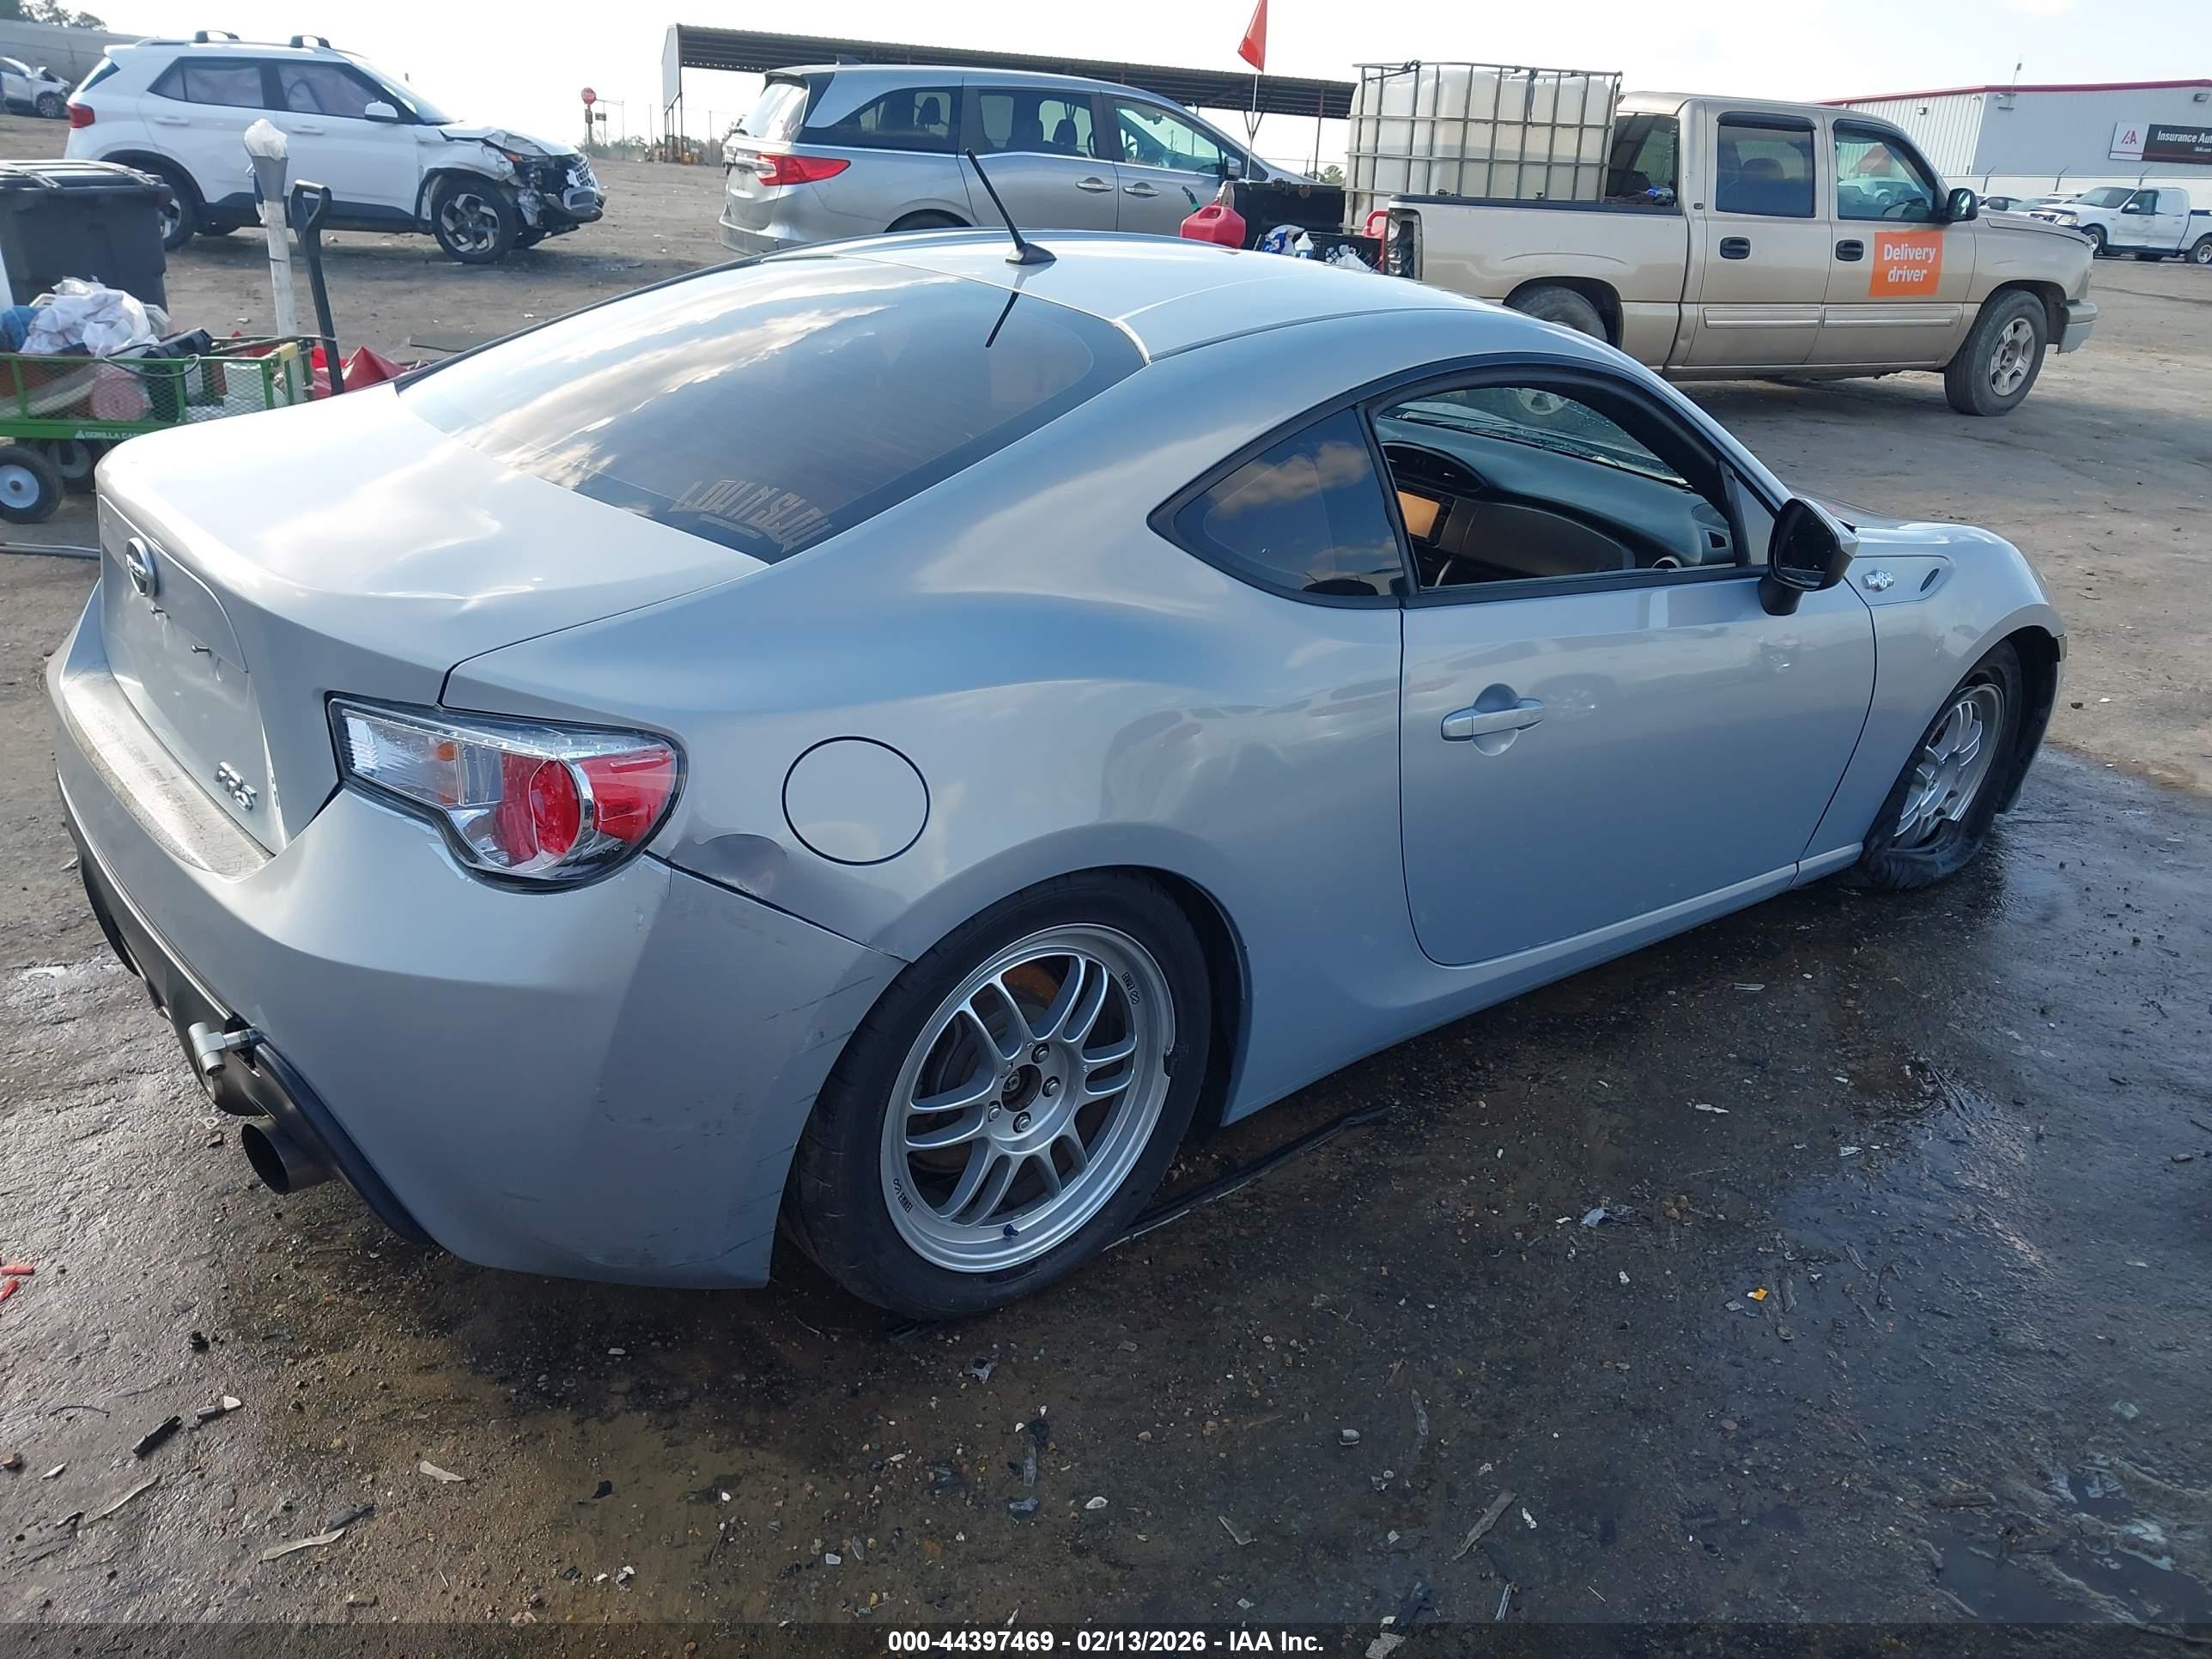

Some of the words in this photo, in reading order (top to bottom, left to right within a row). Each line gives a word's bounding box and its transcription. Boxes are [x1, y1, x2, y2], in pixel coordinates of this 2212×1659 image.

[2157, 130, 2197, 143] Insurance
[1883, 243, 1936, 264] Delivery
[1887, 265, 1928, 283] driver
